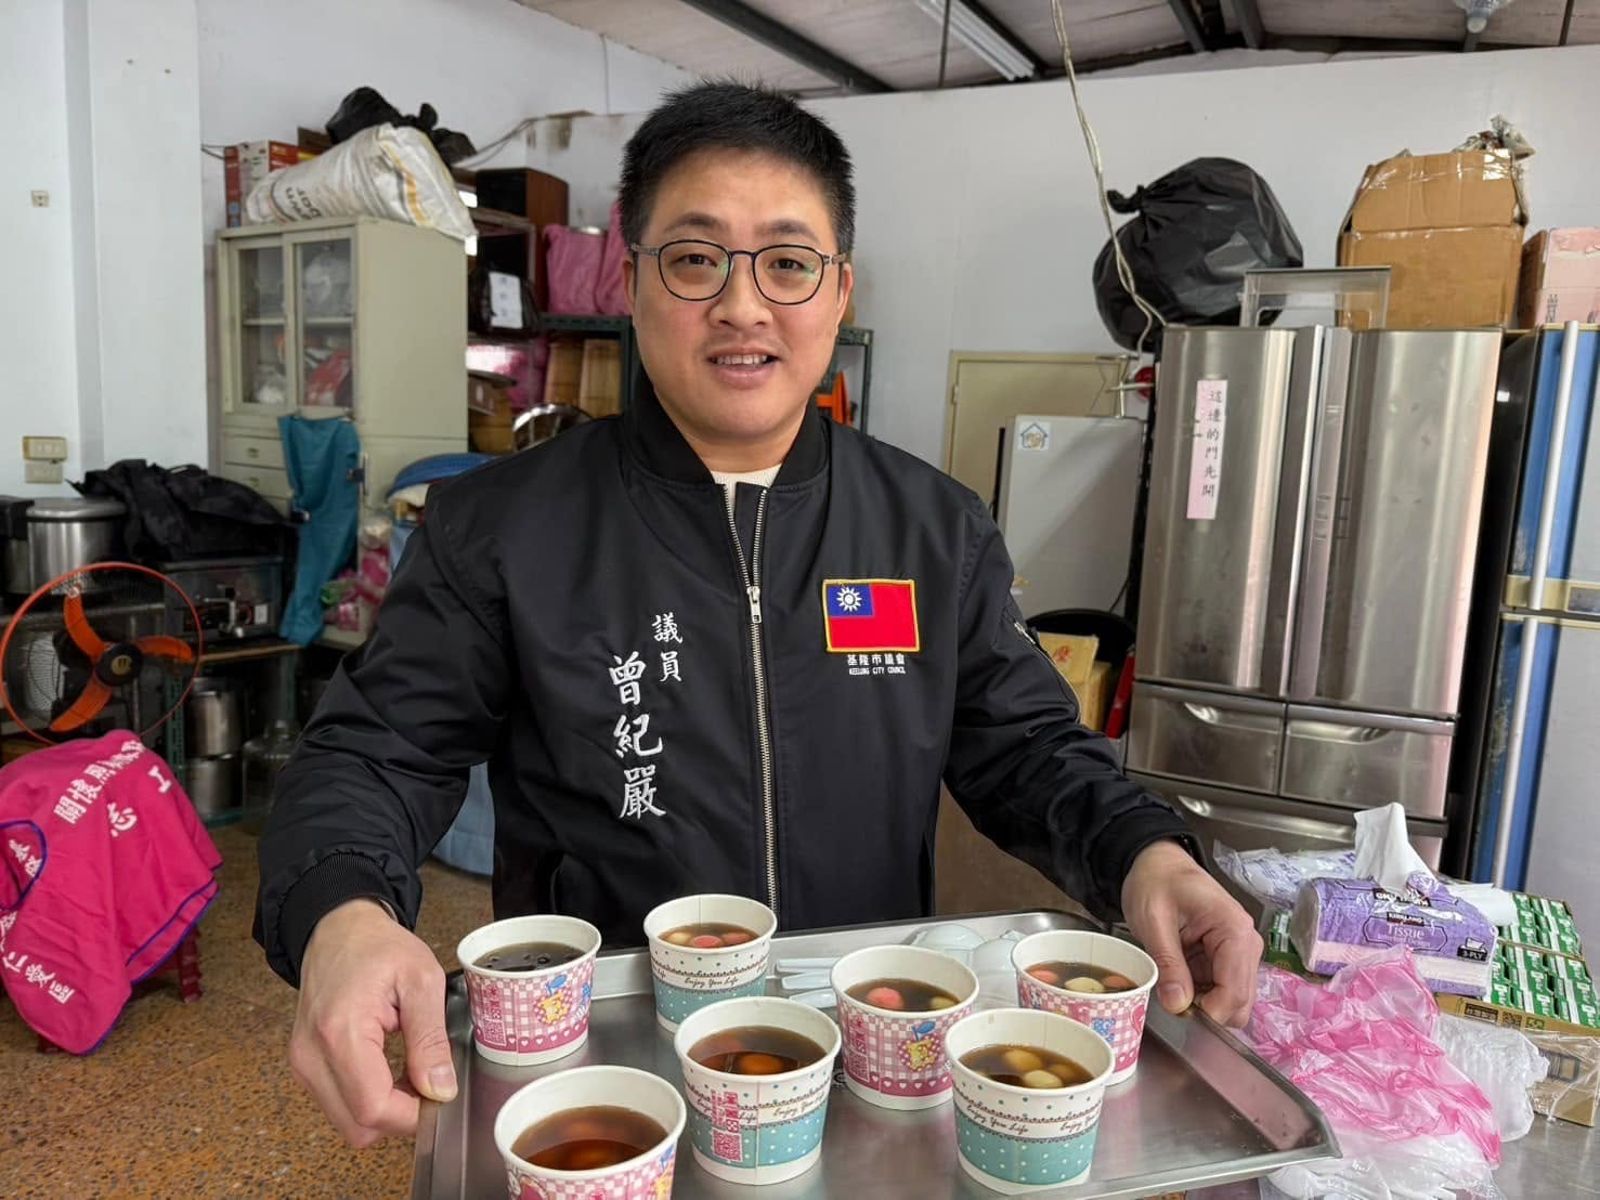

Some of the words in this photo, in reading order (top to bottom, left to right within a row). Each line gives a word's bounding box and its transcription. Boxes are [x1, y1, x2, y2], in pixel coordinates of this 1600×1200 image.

[651, 611, 684, 682] 議員
[872, 666, 885, 675] CITY
[608, 650, 667, 820] 曾紀嚴
[1387, 922, 1425, 939] Tissue
